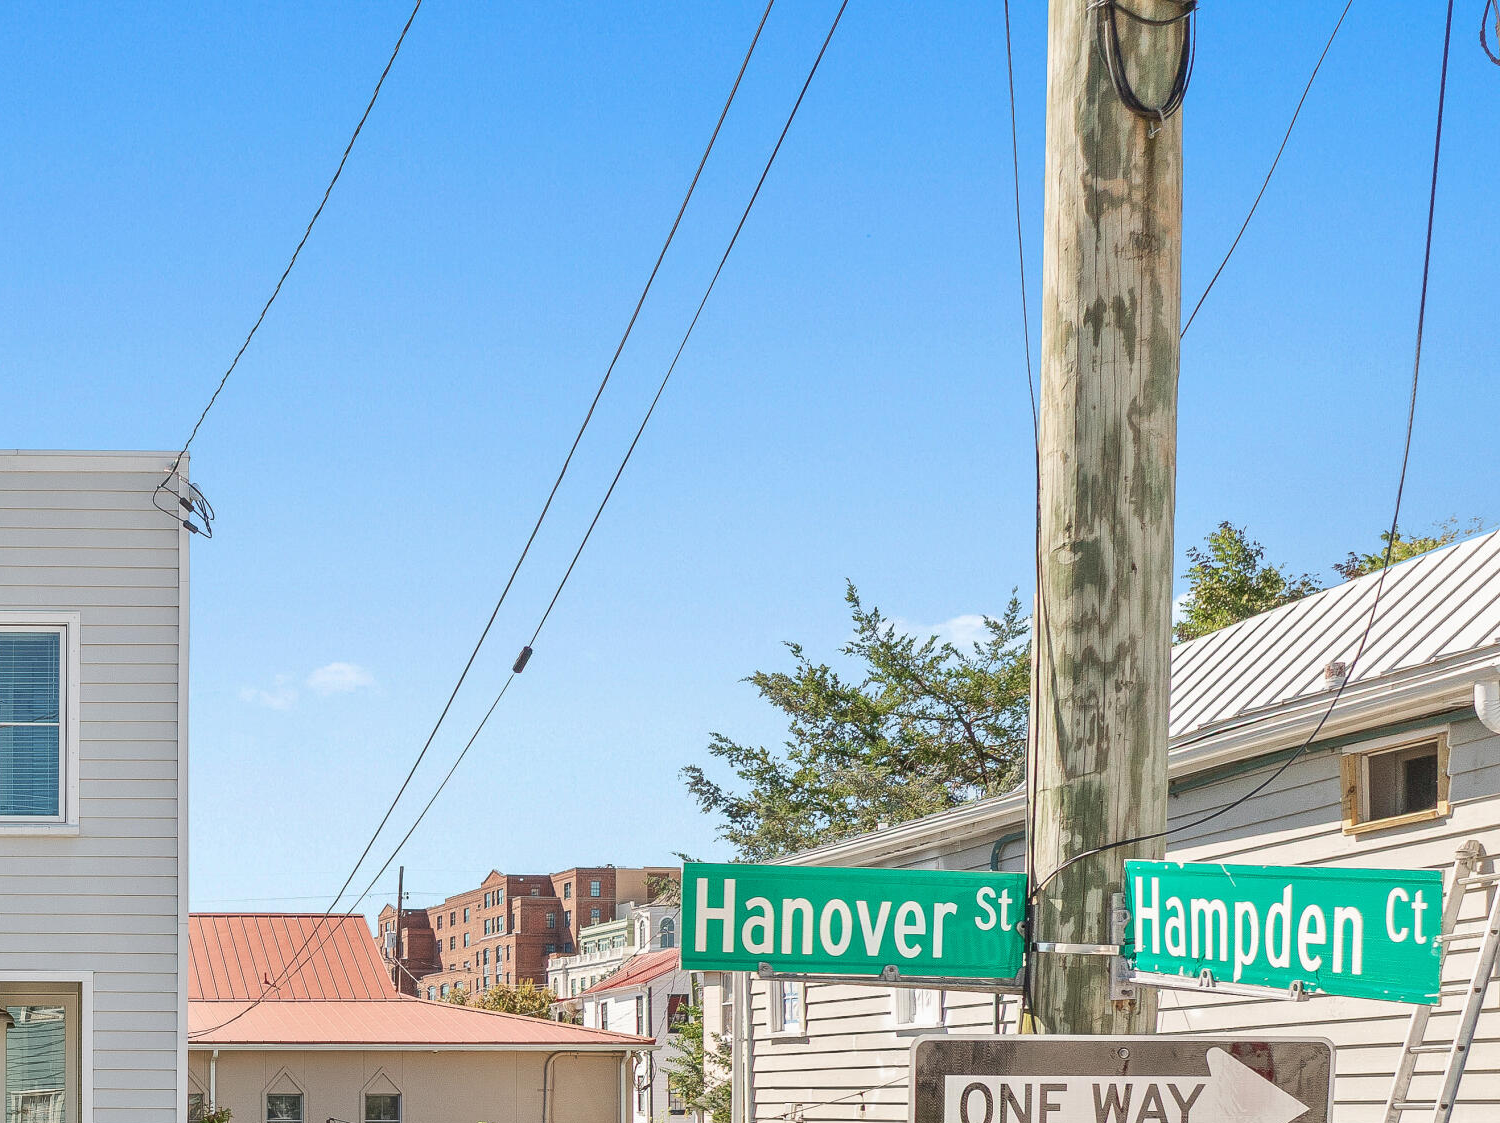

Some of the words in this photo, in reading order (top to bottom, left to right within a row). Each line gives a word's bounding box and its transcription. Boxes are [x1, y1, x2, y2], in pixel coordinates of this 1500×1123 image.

[693, 877, 958, 960] Hanover
[974, 886, 1013, 932] St
[1134, 875, 1363, 984] Hampden
[1385, 887, 1429, 945] Ct
